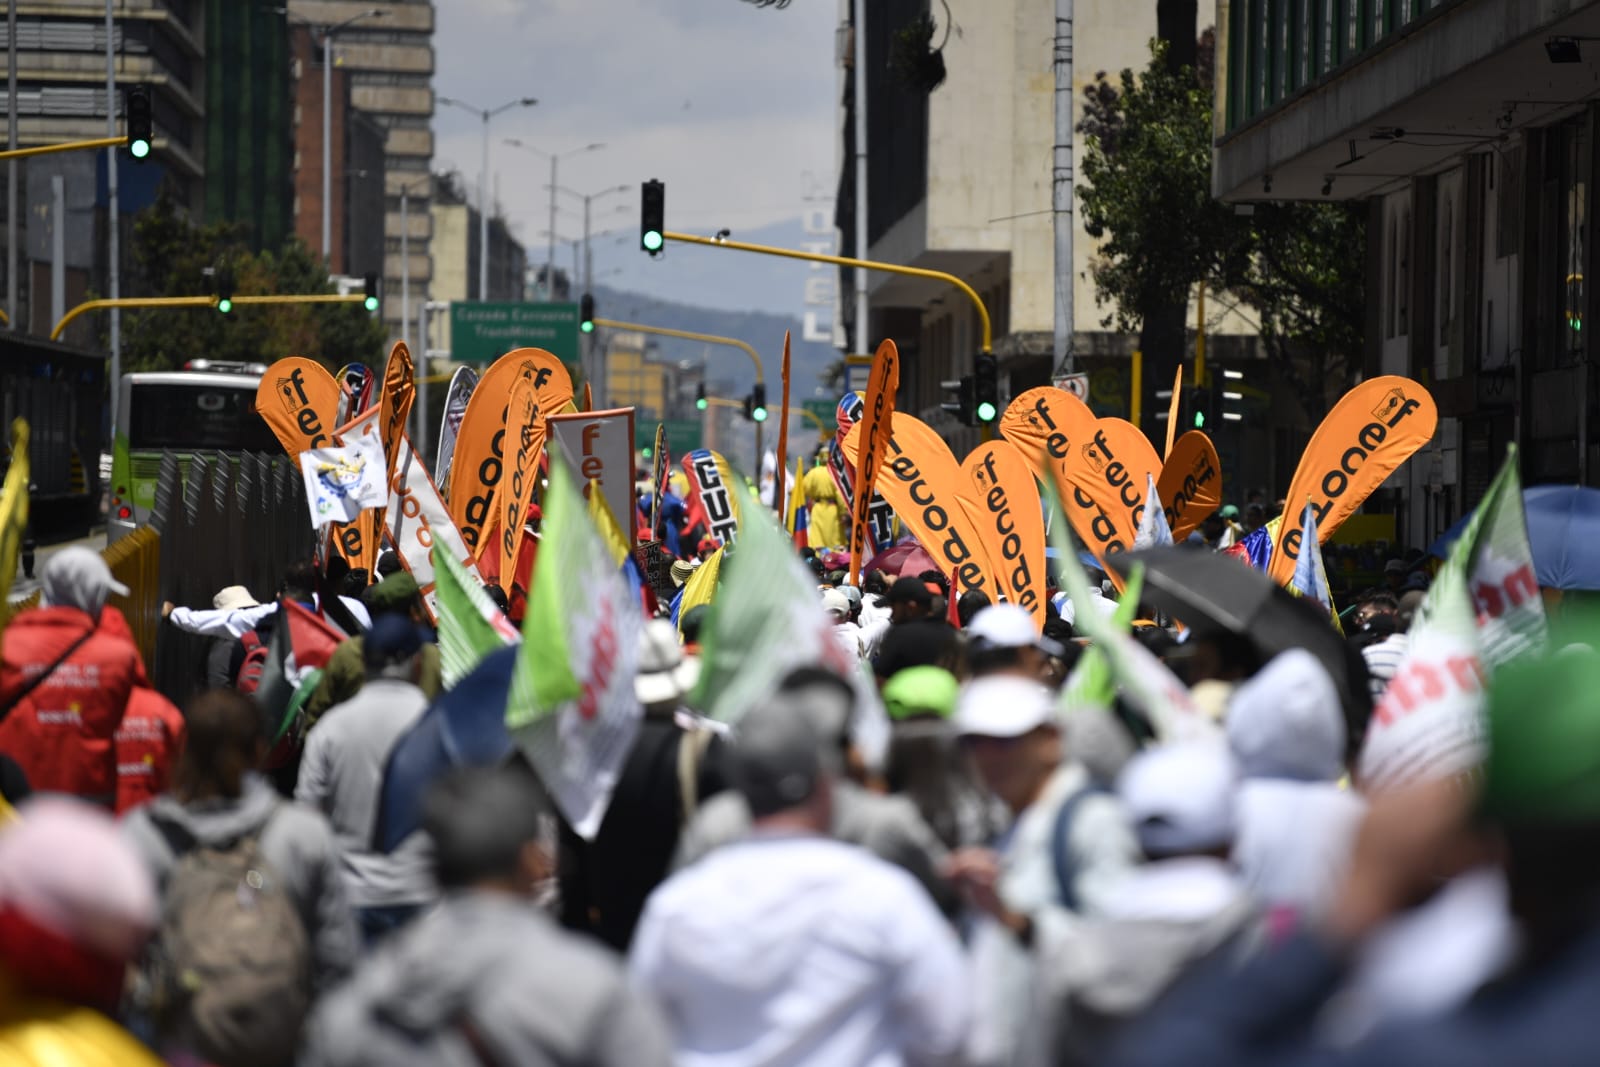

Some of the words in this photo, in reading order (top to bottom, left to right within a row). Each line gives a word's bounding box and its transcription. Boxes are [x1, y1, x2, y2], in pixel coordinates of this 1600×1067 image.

[462, 367, 552, 547] fcode
[504, 403, 539, 559] fecode
[695, 458, 737, 546] CUT
[855, 356, 893, 554] fecode
[984, 451, 1039, 615] fecode
[1094, 429, 1146, 531] feco
[1282, 398, 1420, 560] fecode
